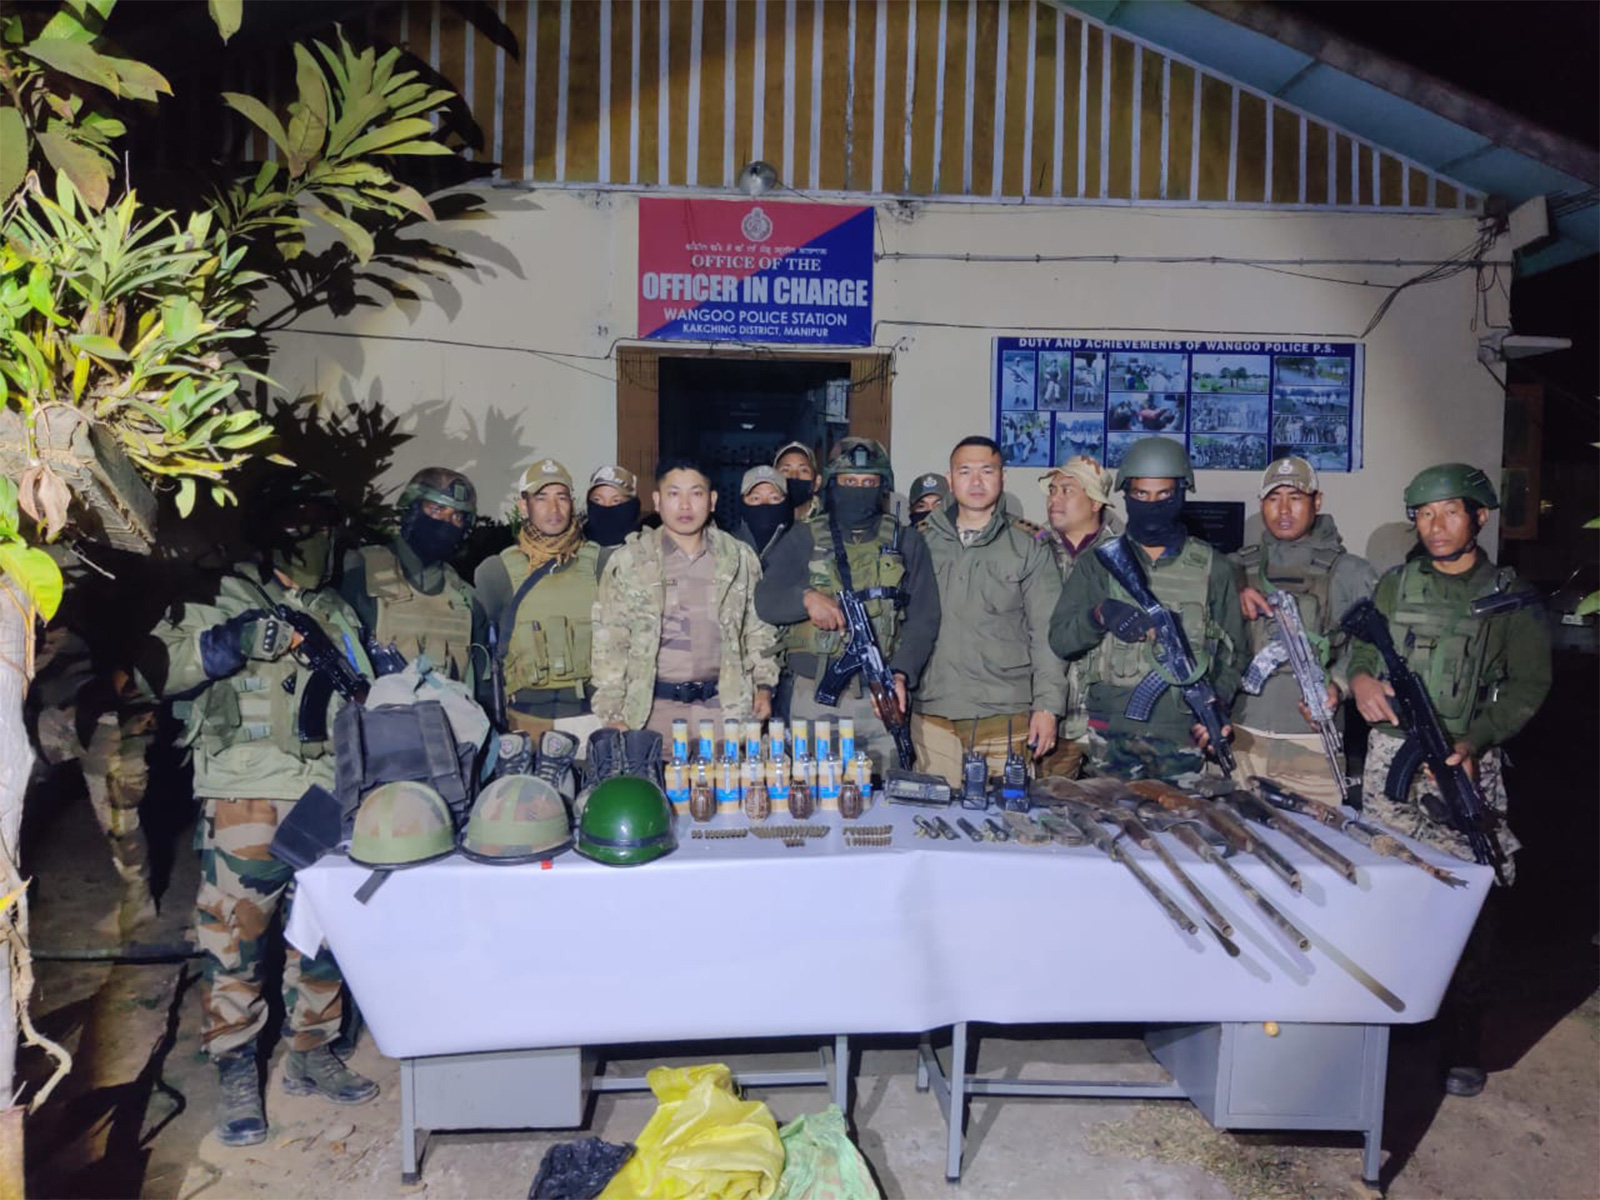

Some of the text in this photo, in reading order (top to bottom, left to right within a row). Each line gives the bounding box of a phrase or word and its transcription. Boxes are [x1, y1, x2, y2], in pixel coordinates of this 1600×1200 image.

[691, 254, 821, 271] OFFICE OF THE
[642, 272, 868, 306] OFFICER IN CHARGE
[664, 308, 847, 326] WANGOO POLICE STATION
[683, 323, 737, 334] KAKCHING
[784, 327, 829, 337] MANIPUR
[1019, 338, 1336, 353] DUTY AND ACHIEVEMENTS OF WANGOO POLICE P.S.
